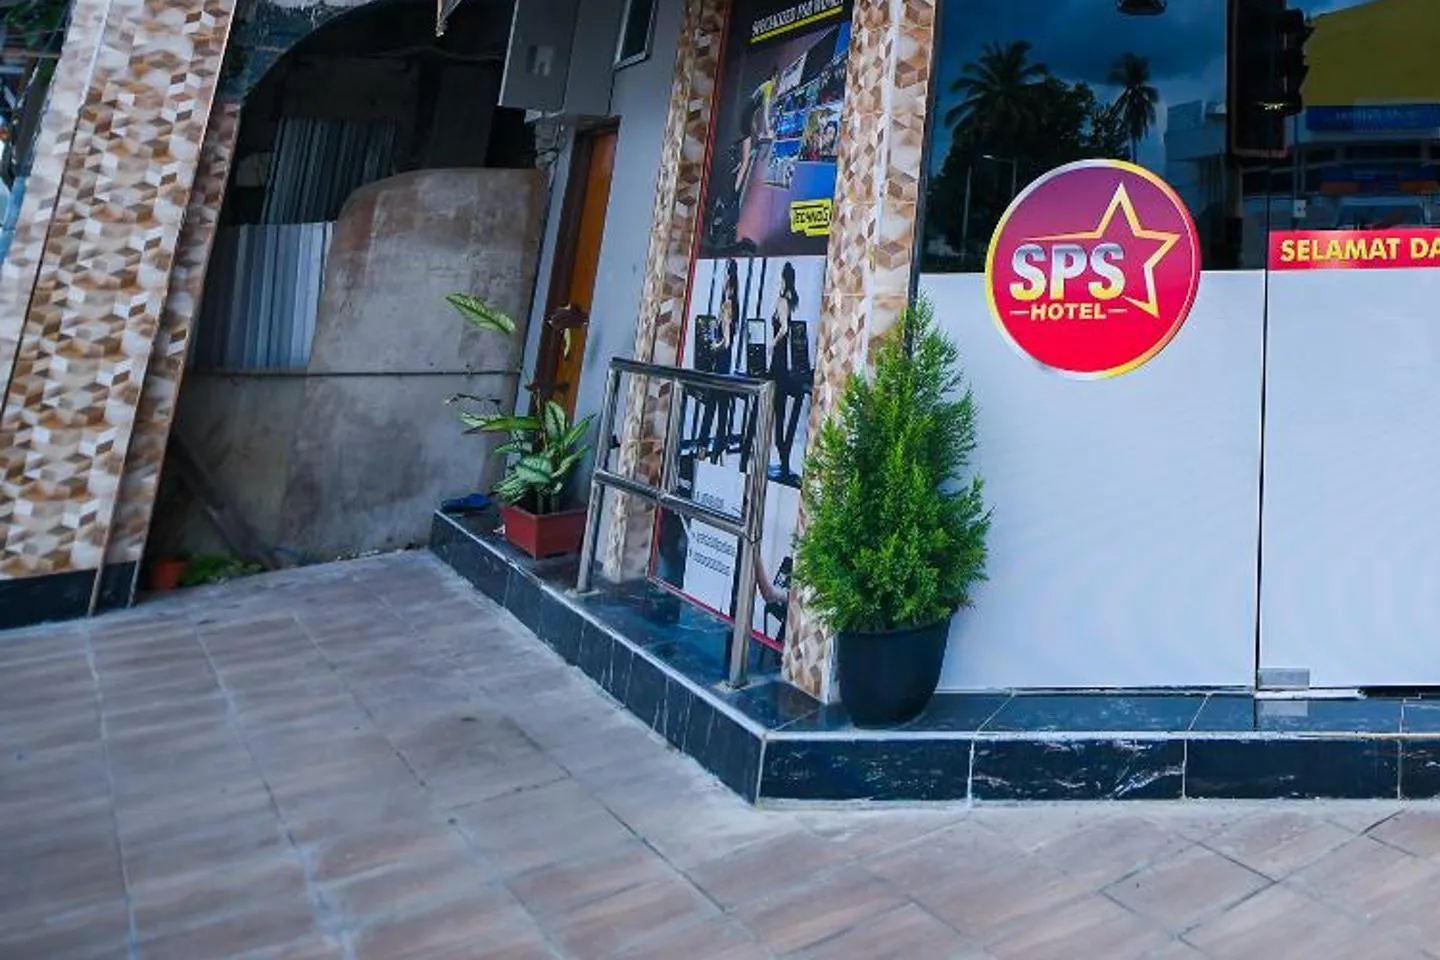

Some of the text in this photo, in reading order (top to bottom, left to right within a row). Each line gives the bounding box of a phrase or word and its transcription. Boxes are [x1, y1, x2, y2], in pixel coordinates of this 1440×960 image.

[1280, 237, 1400, 262] SELAMAT
[1009, 242, 1126, 301] SPS
[1030, 303, 1107, 321] HOTEL
